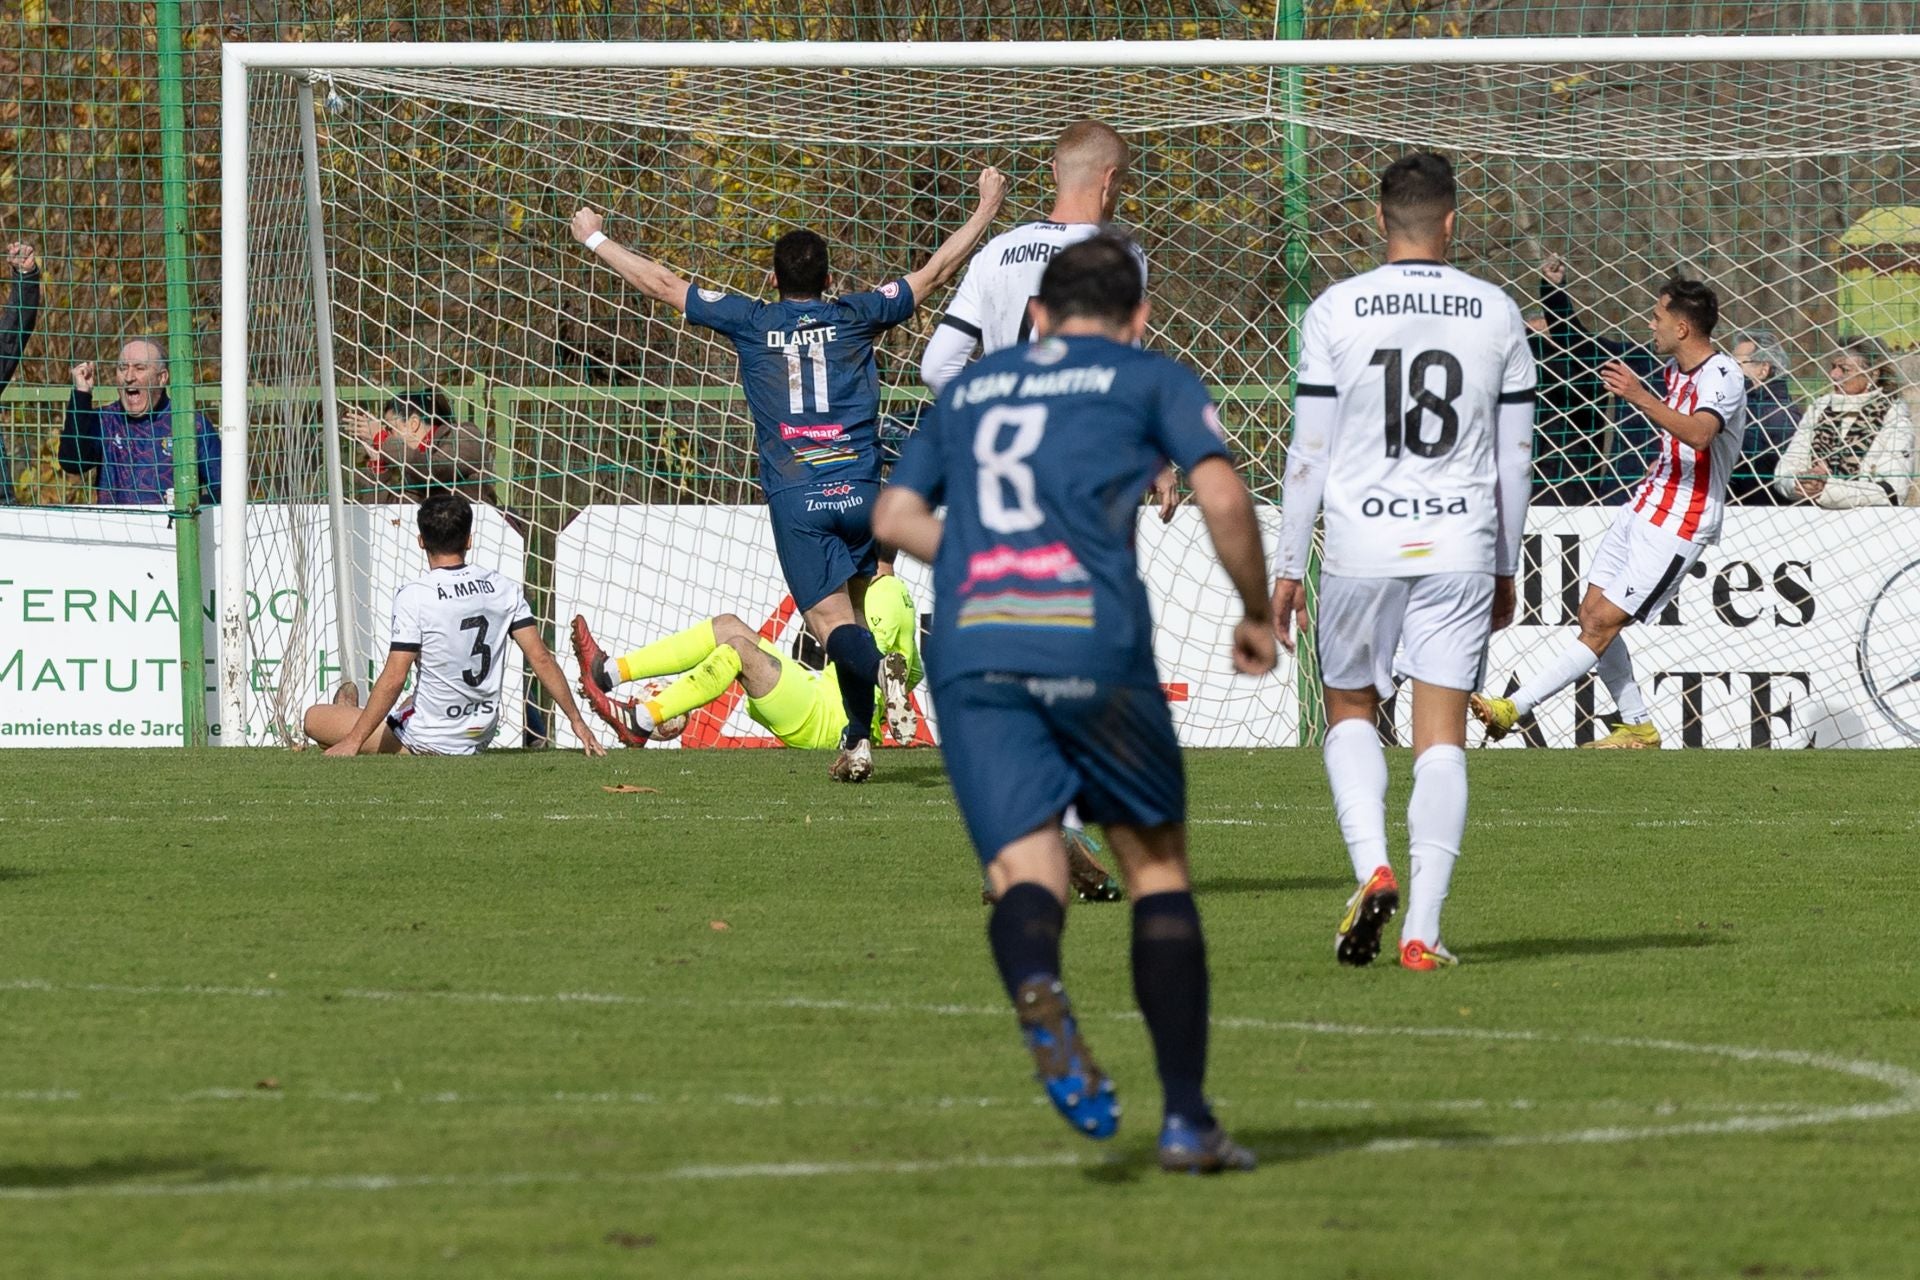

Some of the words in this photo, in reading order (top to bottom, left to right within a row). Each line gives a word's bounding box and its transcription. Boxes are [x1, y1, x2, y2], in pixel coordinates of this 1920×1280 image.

[1000, 242, 1062, 267] MONR
[1355, 293, 1483, 319] CABALLERO
[767, 325, 838, 348] OLARTE
[782, 343, 830, 415] 11
[1368, 348, 1464, 459] 18
[973, 405, 1049, 534] 8
[805, 495, 864, 515] Zorropito
[1361, 496, 1469, 520] ocisa
[454, 579, 495, 598] MATEO
[459, 614, 491, 688] 3
[0, 649, 217, 693] MATUT
[446, 700, 500, 718] ocis
[108, 719, 136, 737] de
